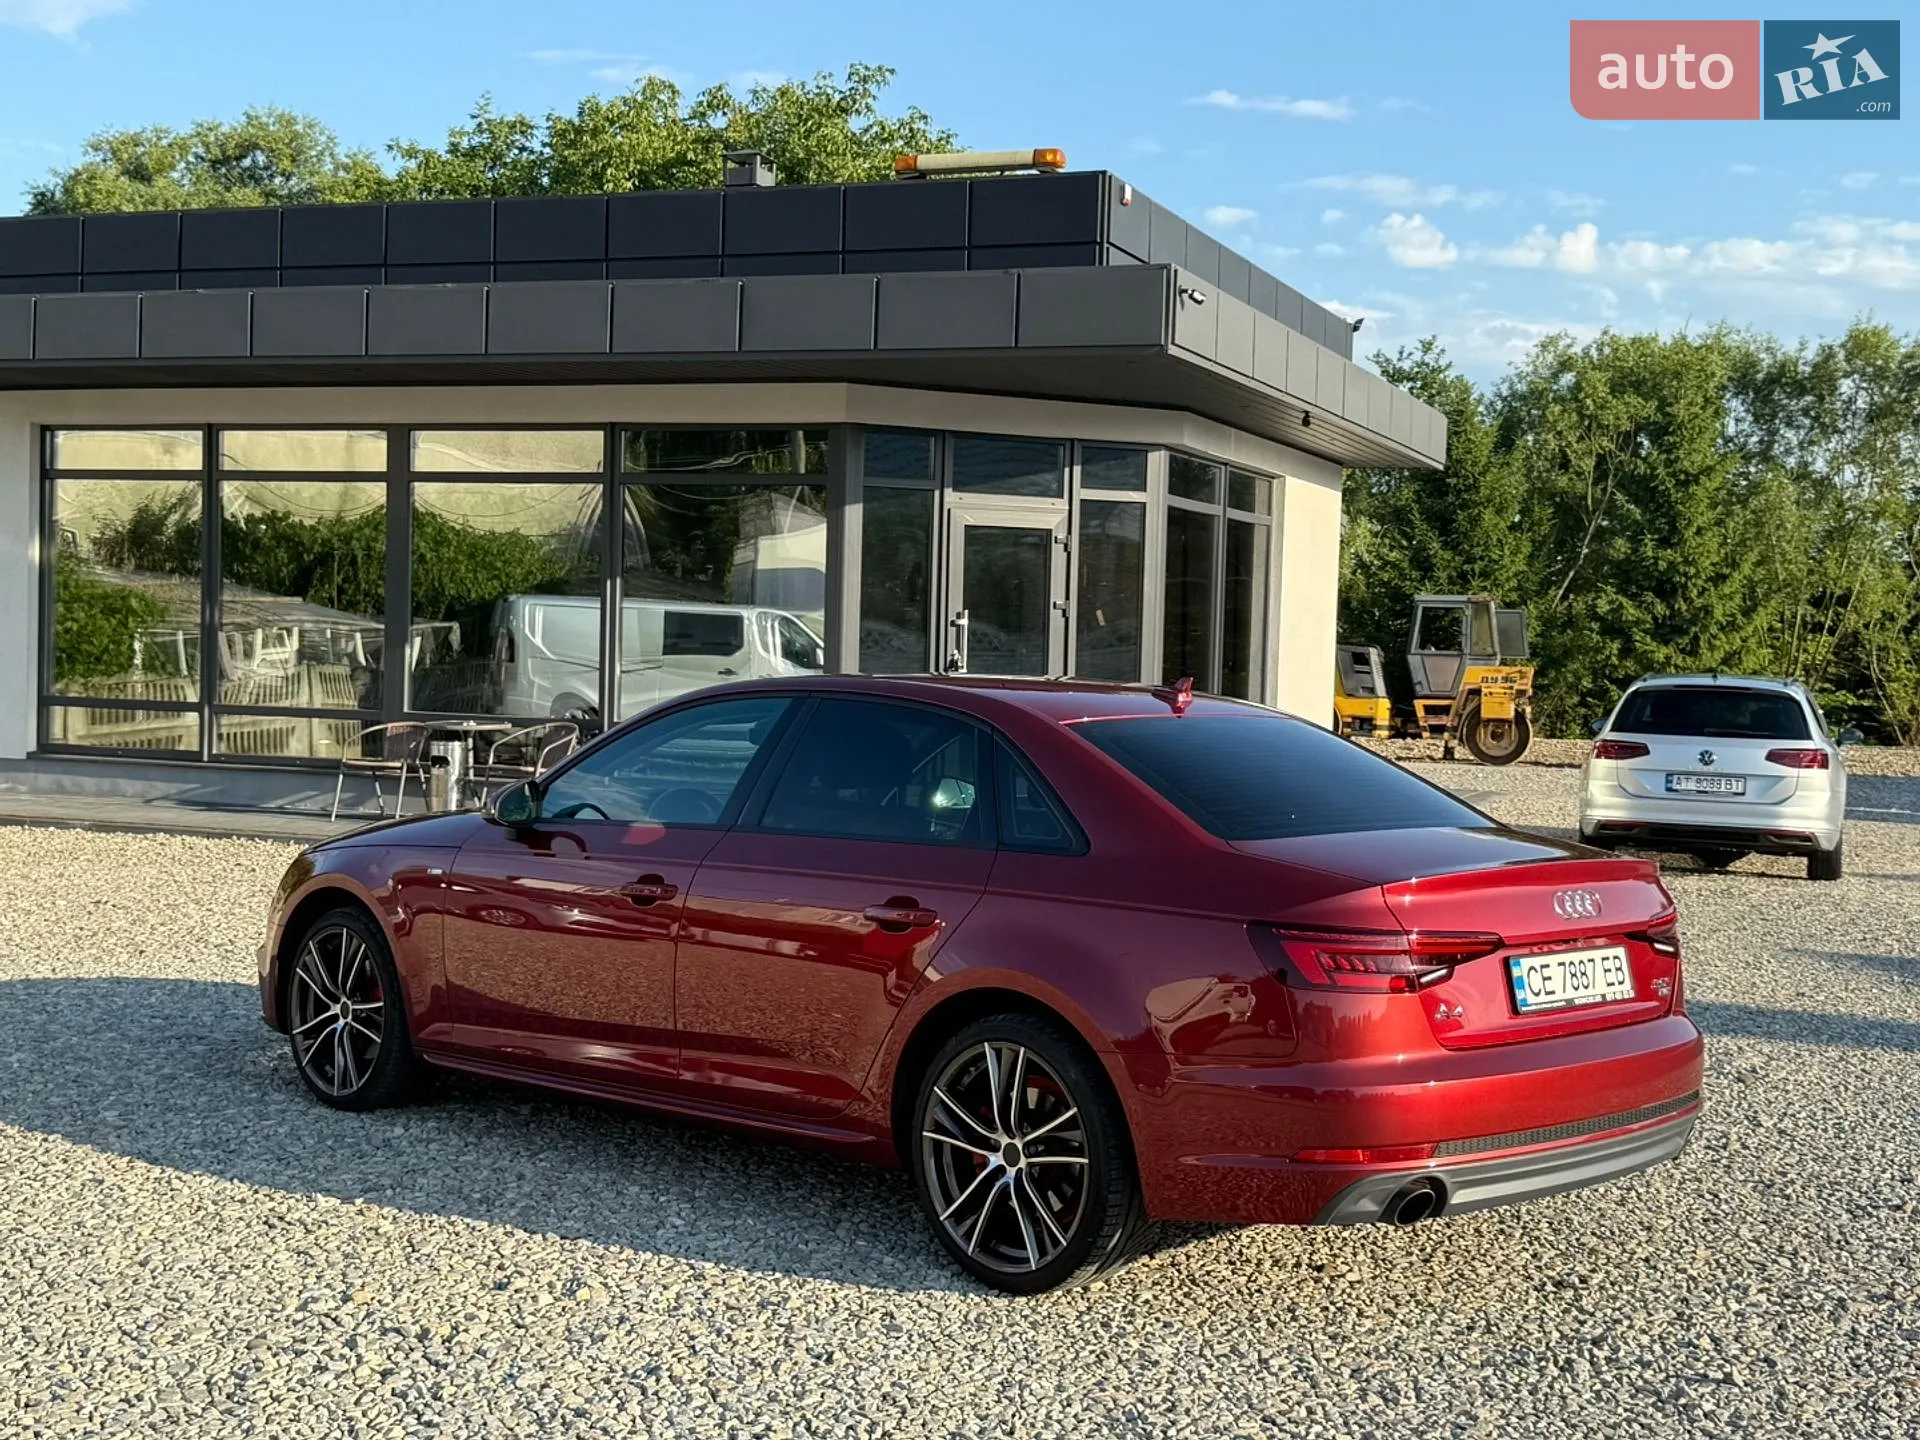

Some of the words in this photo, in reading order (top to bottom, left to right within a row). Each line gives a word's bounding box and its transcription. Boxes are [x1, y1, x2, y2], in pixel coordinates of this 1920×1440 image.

[1675, 776, 1692, 789] AT
[1725, 779, 1743, 792] BT
[1526, 964, 1556, 997] CE
[1557, 958, 1596, 994] 7887
[1601, 955, 1626, 987] EB
